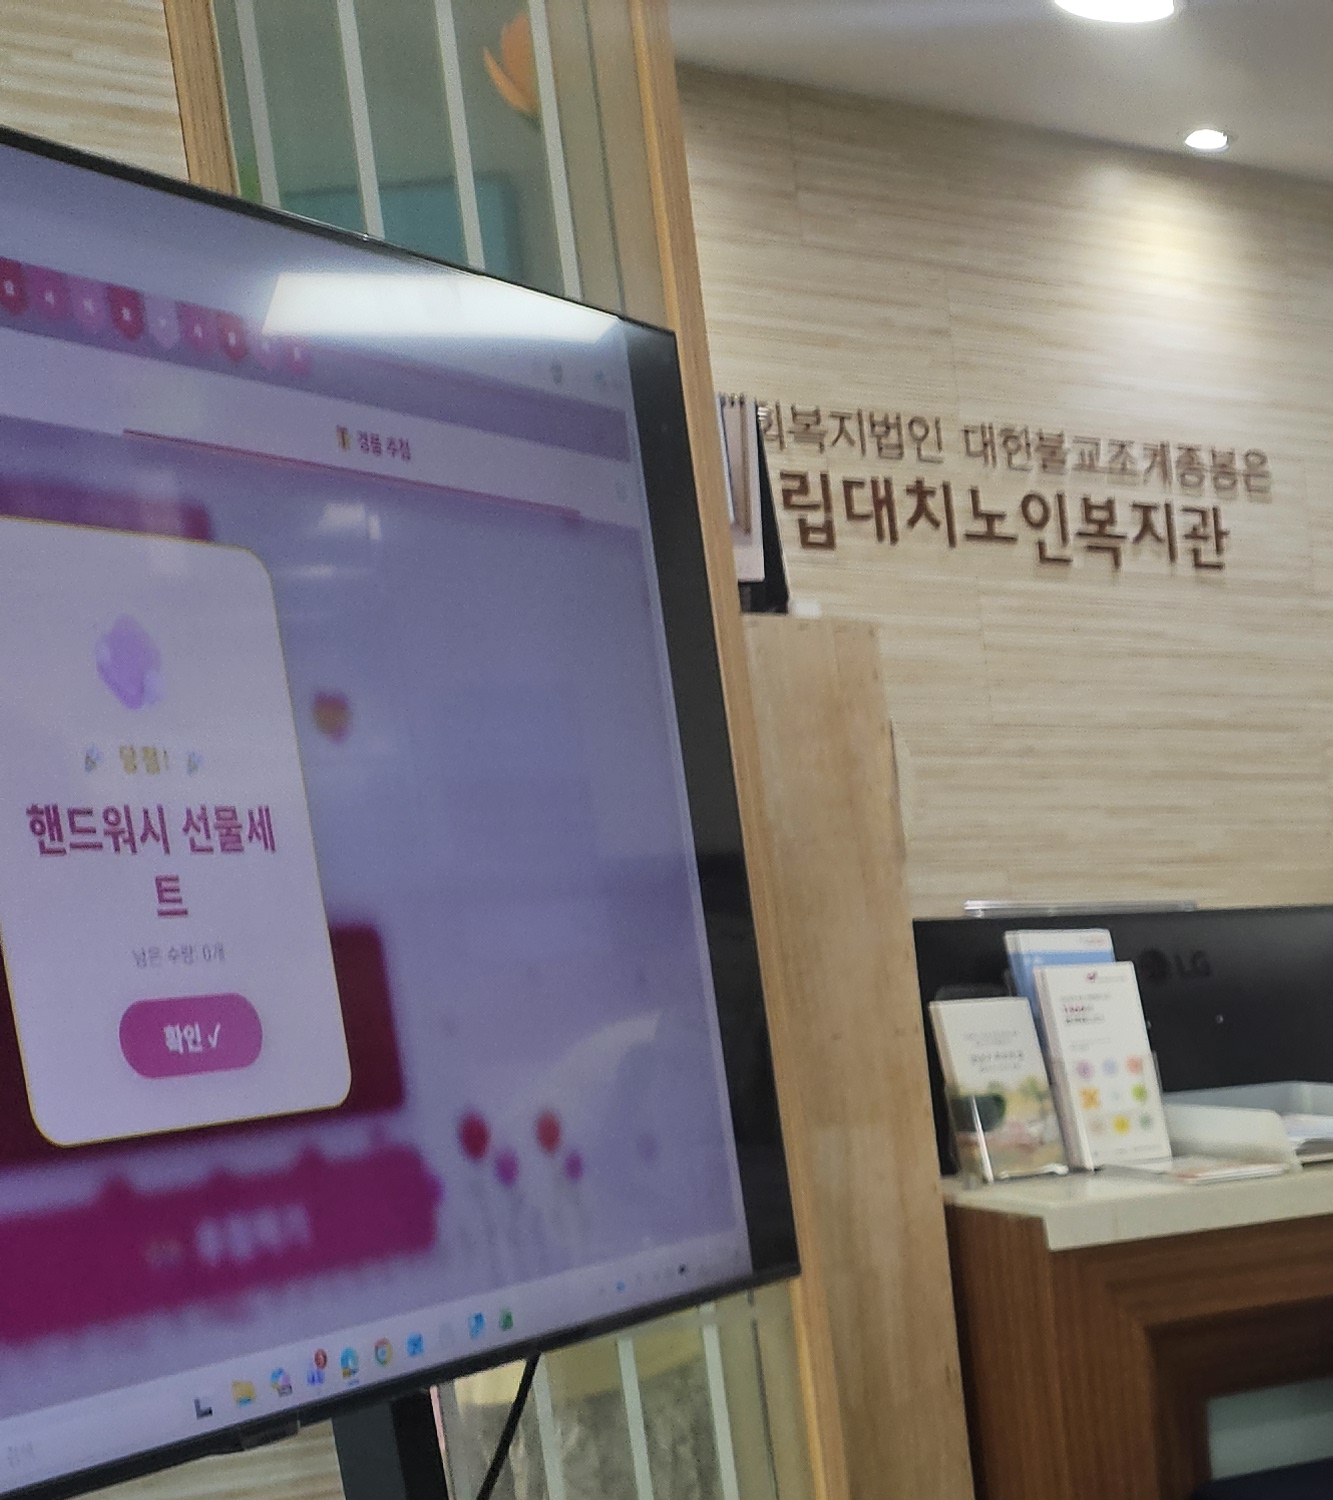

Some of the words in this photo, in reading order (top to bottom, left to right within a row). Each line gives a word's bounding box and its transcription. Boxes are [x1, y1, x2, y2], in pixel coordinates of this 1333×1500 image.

[780, 469, 1230, 571] 립대치노인복지관
[26, 804, 171, 857] 핸드워시
[182, 804, 277, 853] 선물세
[155, 875, 189, 919] 트
[162, 1021, 204, 1056] 확인
